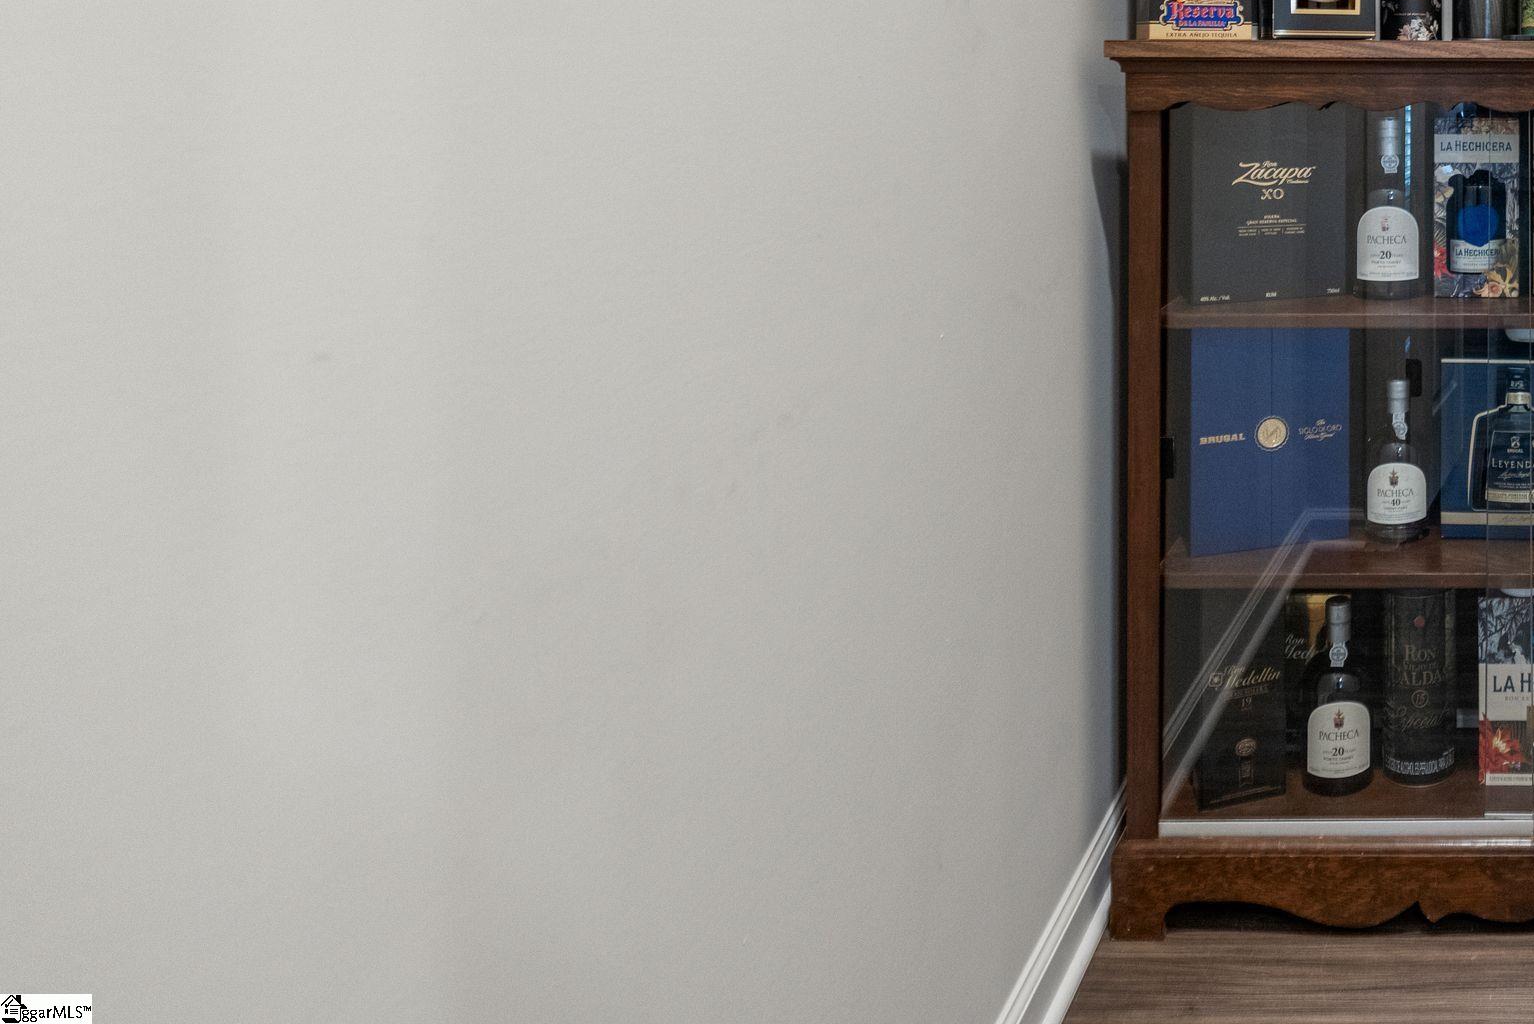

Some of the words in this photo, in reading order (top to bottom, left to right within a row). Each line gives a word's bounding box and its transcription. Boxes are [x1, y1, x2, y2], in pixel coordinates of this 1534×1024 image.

[1168, 0, 1234, 20] Reserva
[1440, 142, 1452, 151] LA
[1455, 140, 1512, 151] HECHICERA
[1232, 161, 1313, 185] Zacapa
[1261, 188, 1284, 200] XO
[1367, 235, 1407, 245] PACHECA
[1380, 251, 1392, 259] 20
[1456, 248, 1463, 256] LA
[1200, 433, 1245, 445] BRUGAL
[1377, 488, 1414, 497] PACHECA
[1391, 498, 1401, 506] 40
[1493, 675, 1515, 693] LA
[1319, 729, 1359, 741] PACHECA
[1332, 747, 1345, 756] 20
